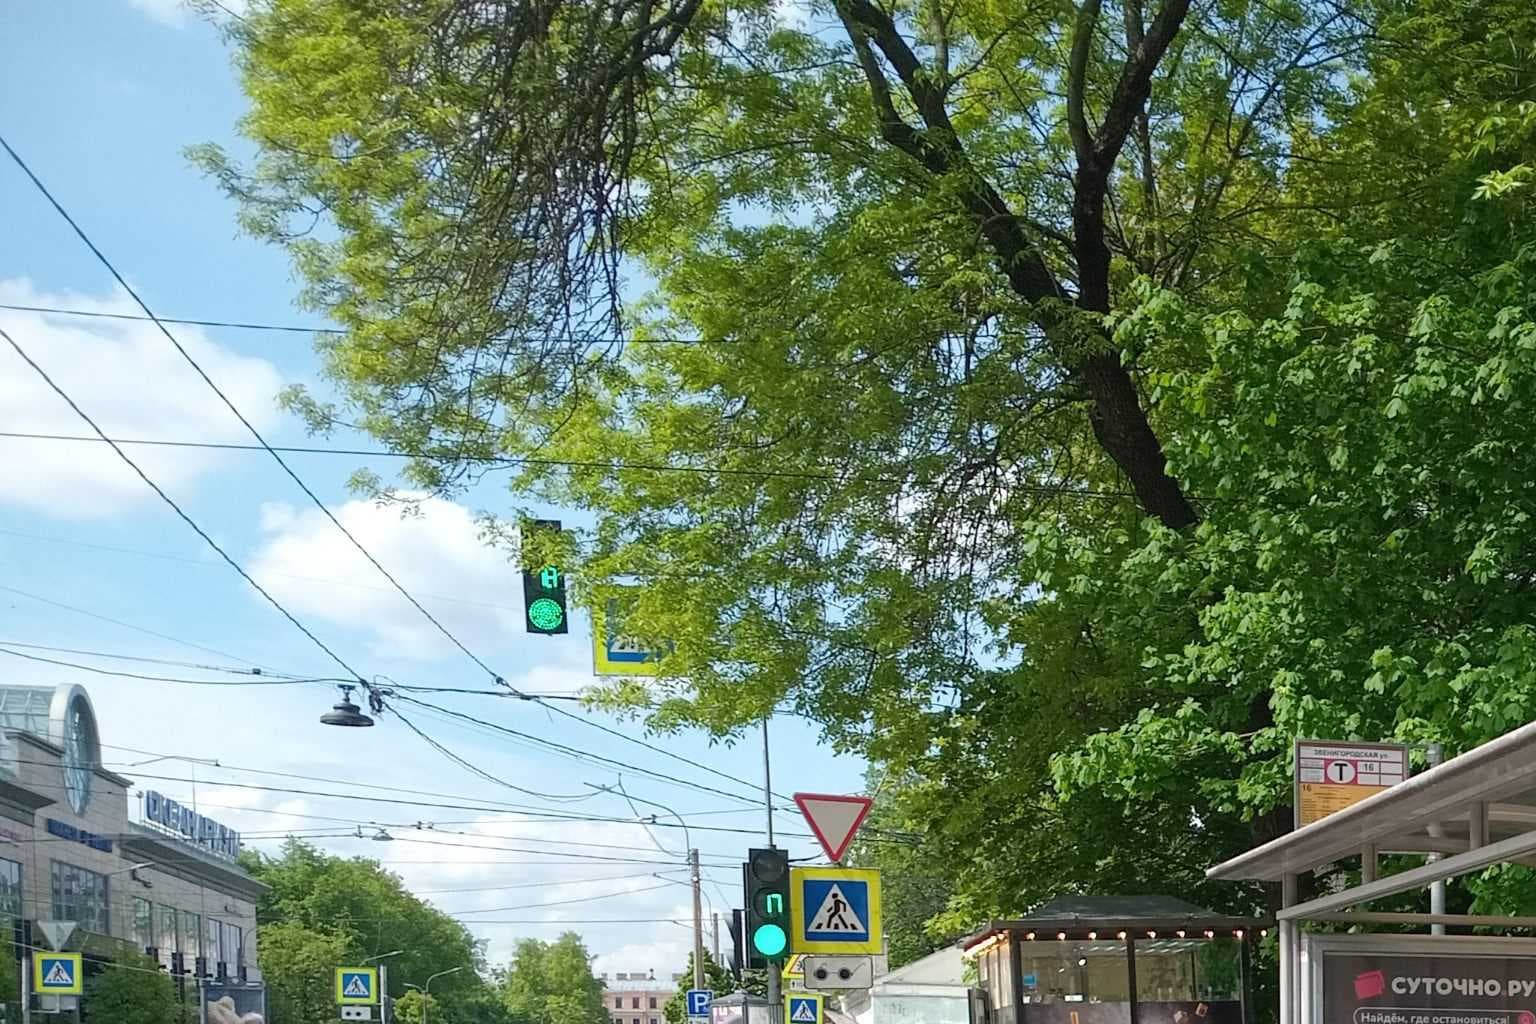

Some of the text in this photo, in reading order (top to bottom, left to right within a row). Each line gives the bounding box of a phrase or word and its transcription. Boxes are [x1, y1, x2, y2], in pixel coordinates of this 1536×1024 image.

[1363, 763, 1374, 771] 16
[1391, 976, 1536, 997] СУТОЧНО.РУ
[694, 993, 708, 1013] P
[1360, 1011, 1408, 1024] Найдём,
